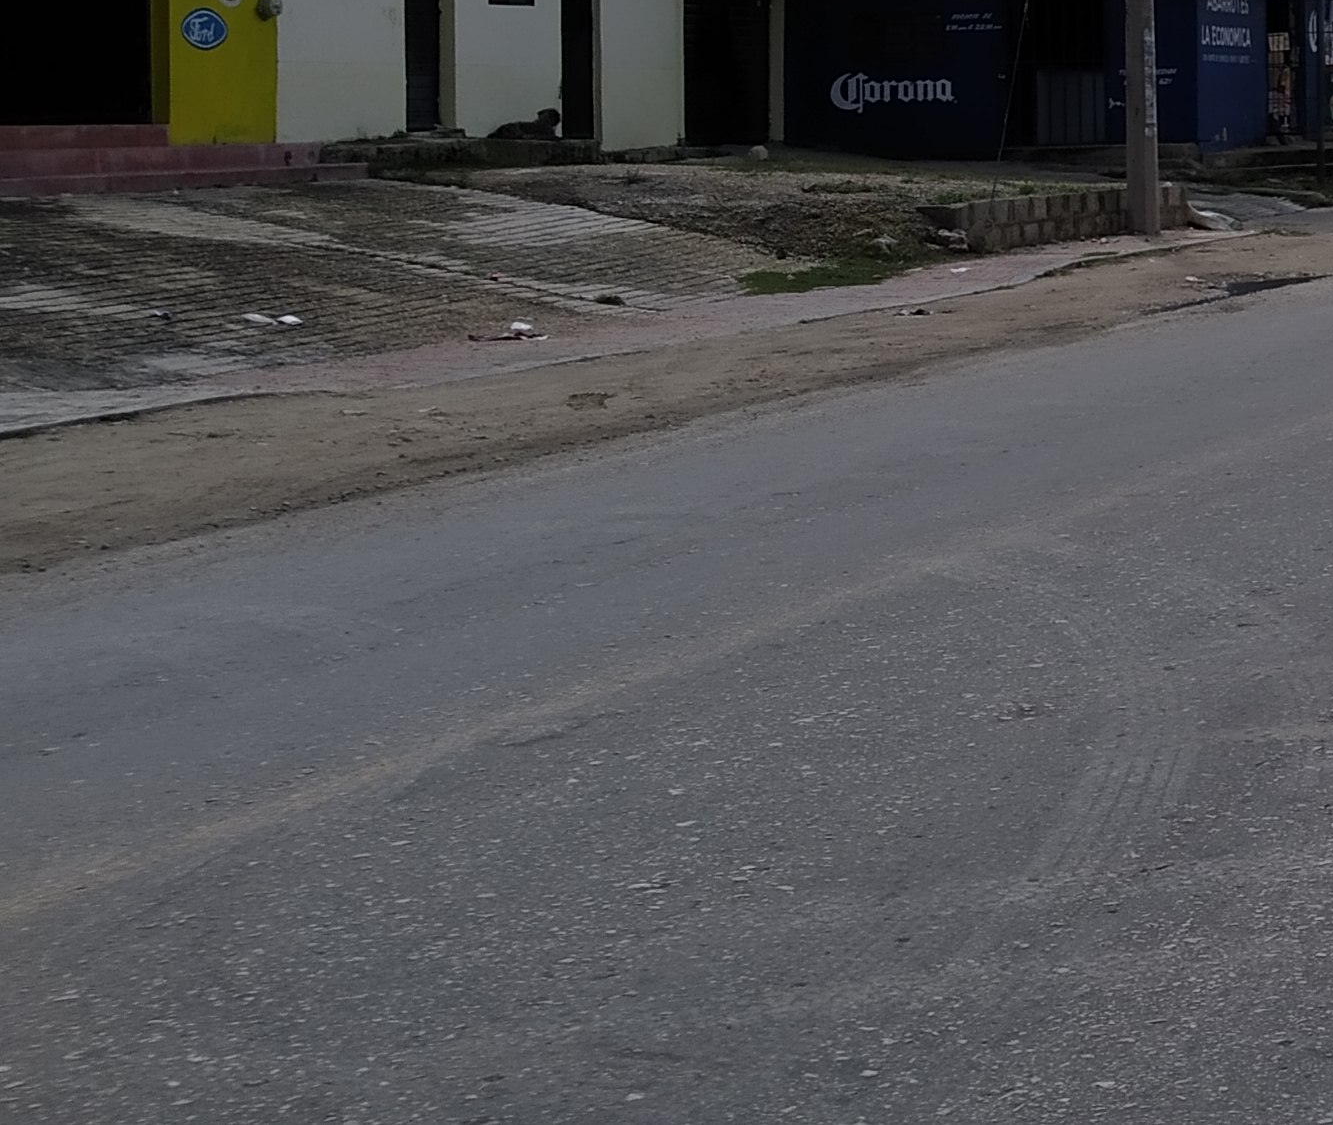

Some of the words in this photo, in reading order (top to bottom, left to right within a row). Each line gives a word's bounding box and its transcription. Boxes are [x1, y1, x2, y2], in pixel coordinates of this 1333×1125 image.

[188, 16, 216, 42] Ford
[1201, 25, 1211, 46] LA
[1211, 25, 1251, 48] ECONOMICA
[830, 71, 957, 114] Corona
